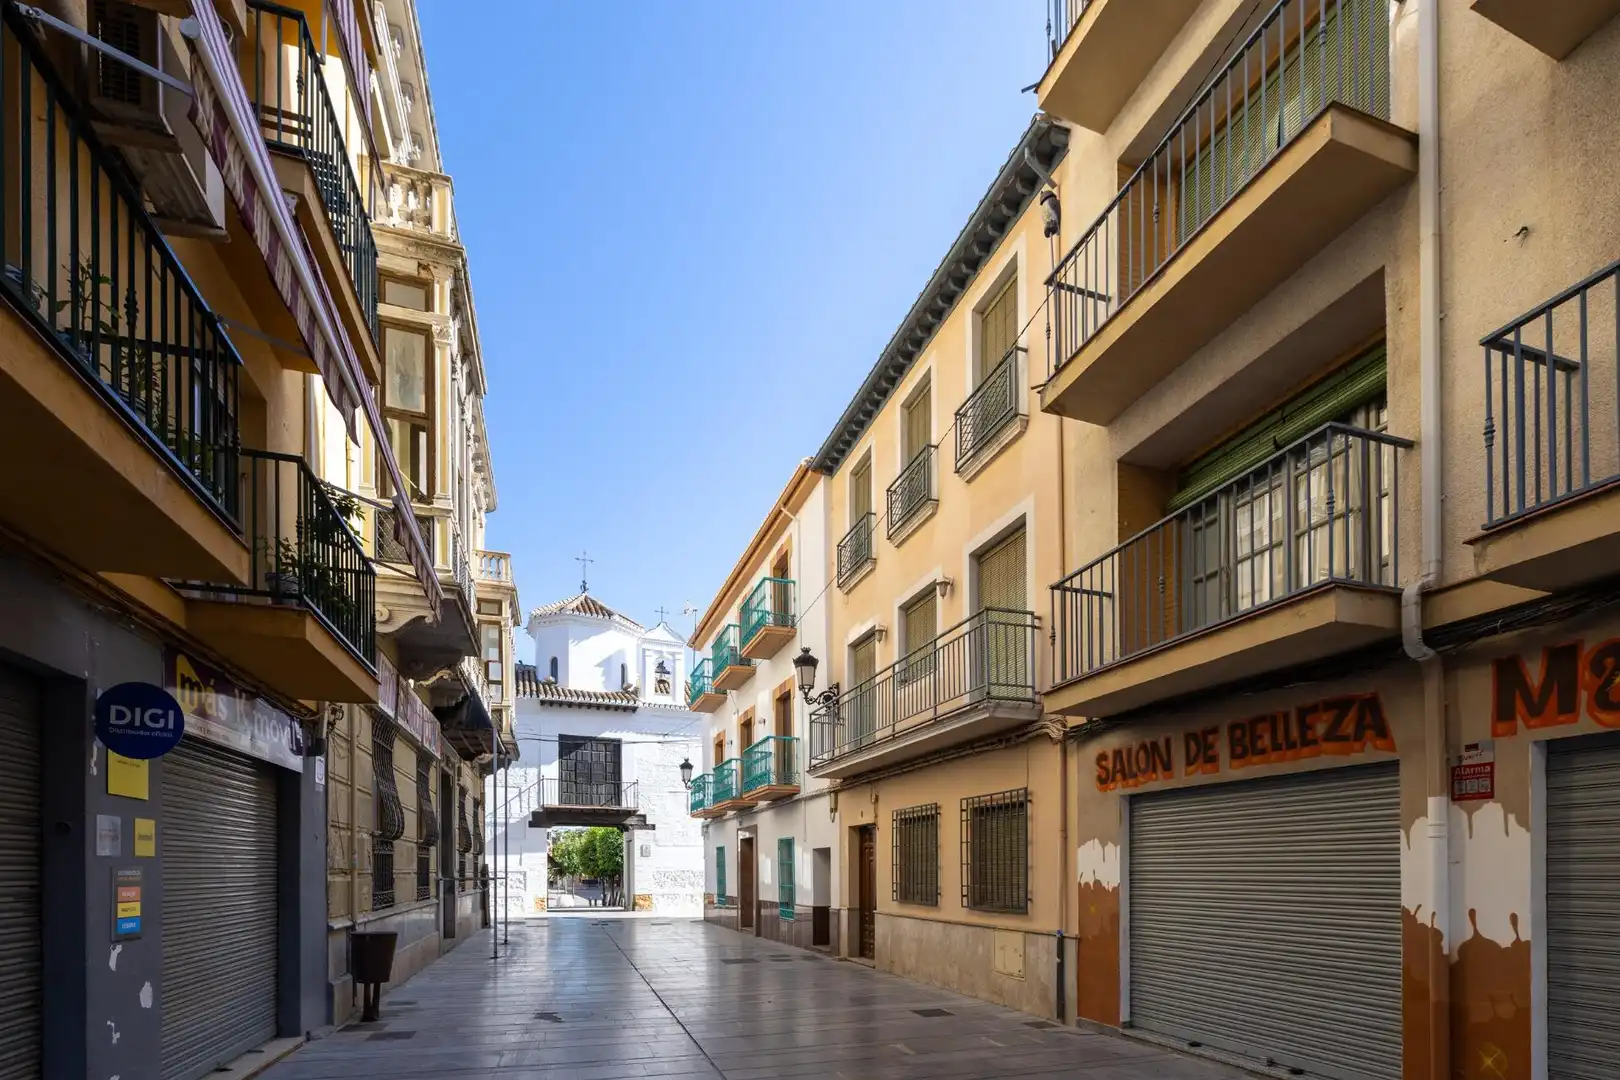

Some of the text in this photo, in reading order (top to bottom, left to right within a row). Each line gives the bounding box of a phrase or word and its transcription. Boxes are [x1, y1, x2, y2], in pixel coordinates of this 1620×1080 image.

[109, 704, 175, 730] DIGI
[1095, 692, 1397, 791] SALON DE BELLEZA
[1454, 765, 1491, 777] Alarma
